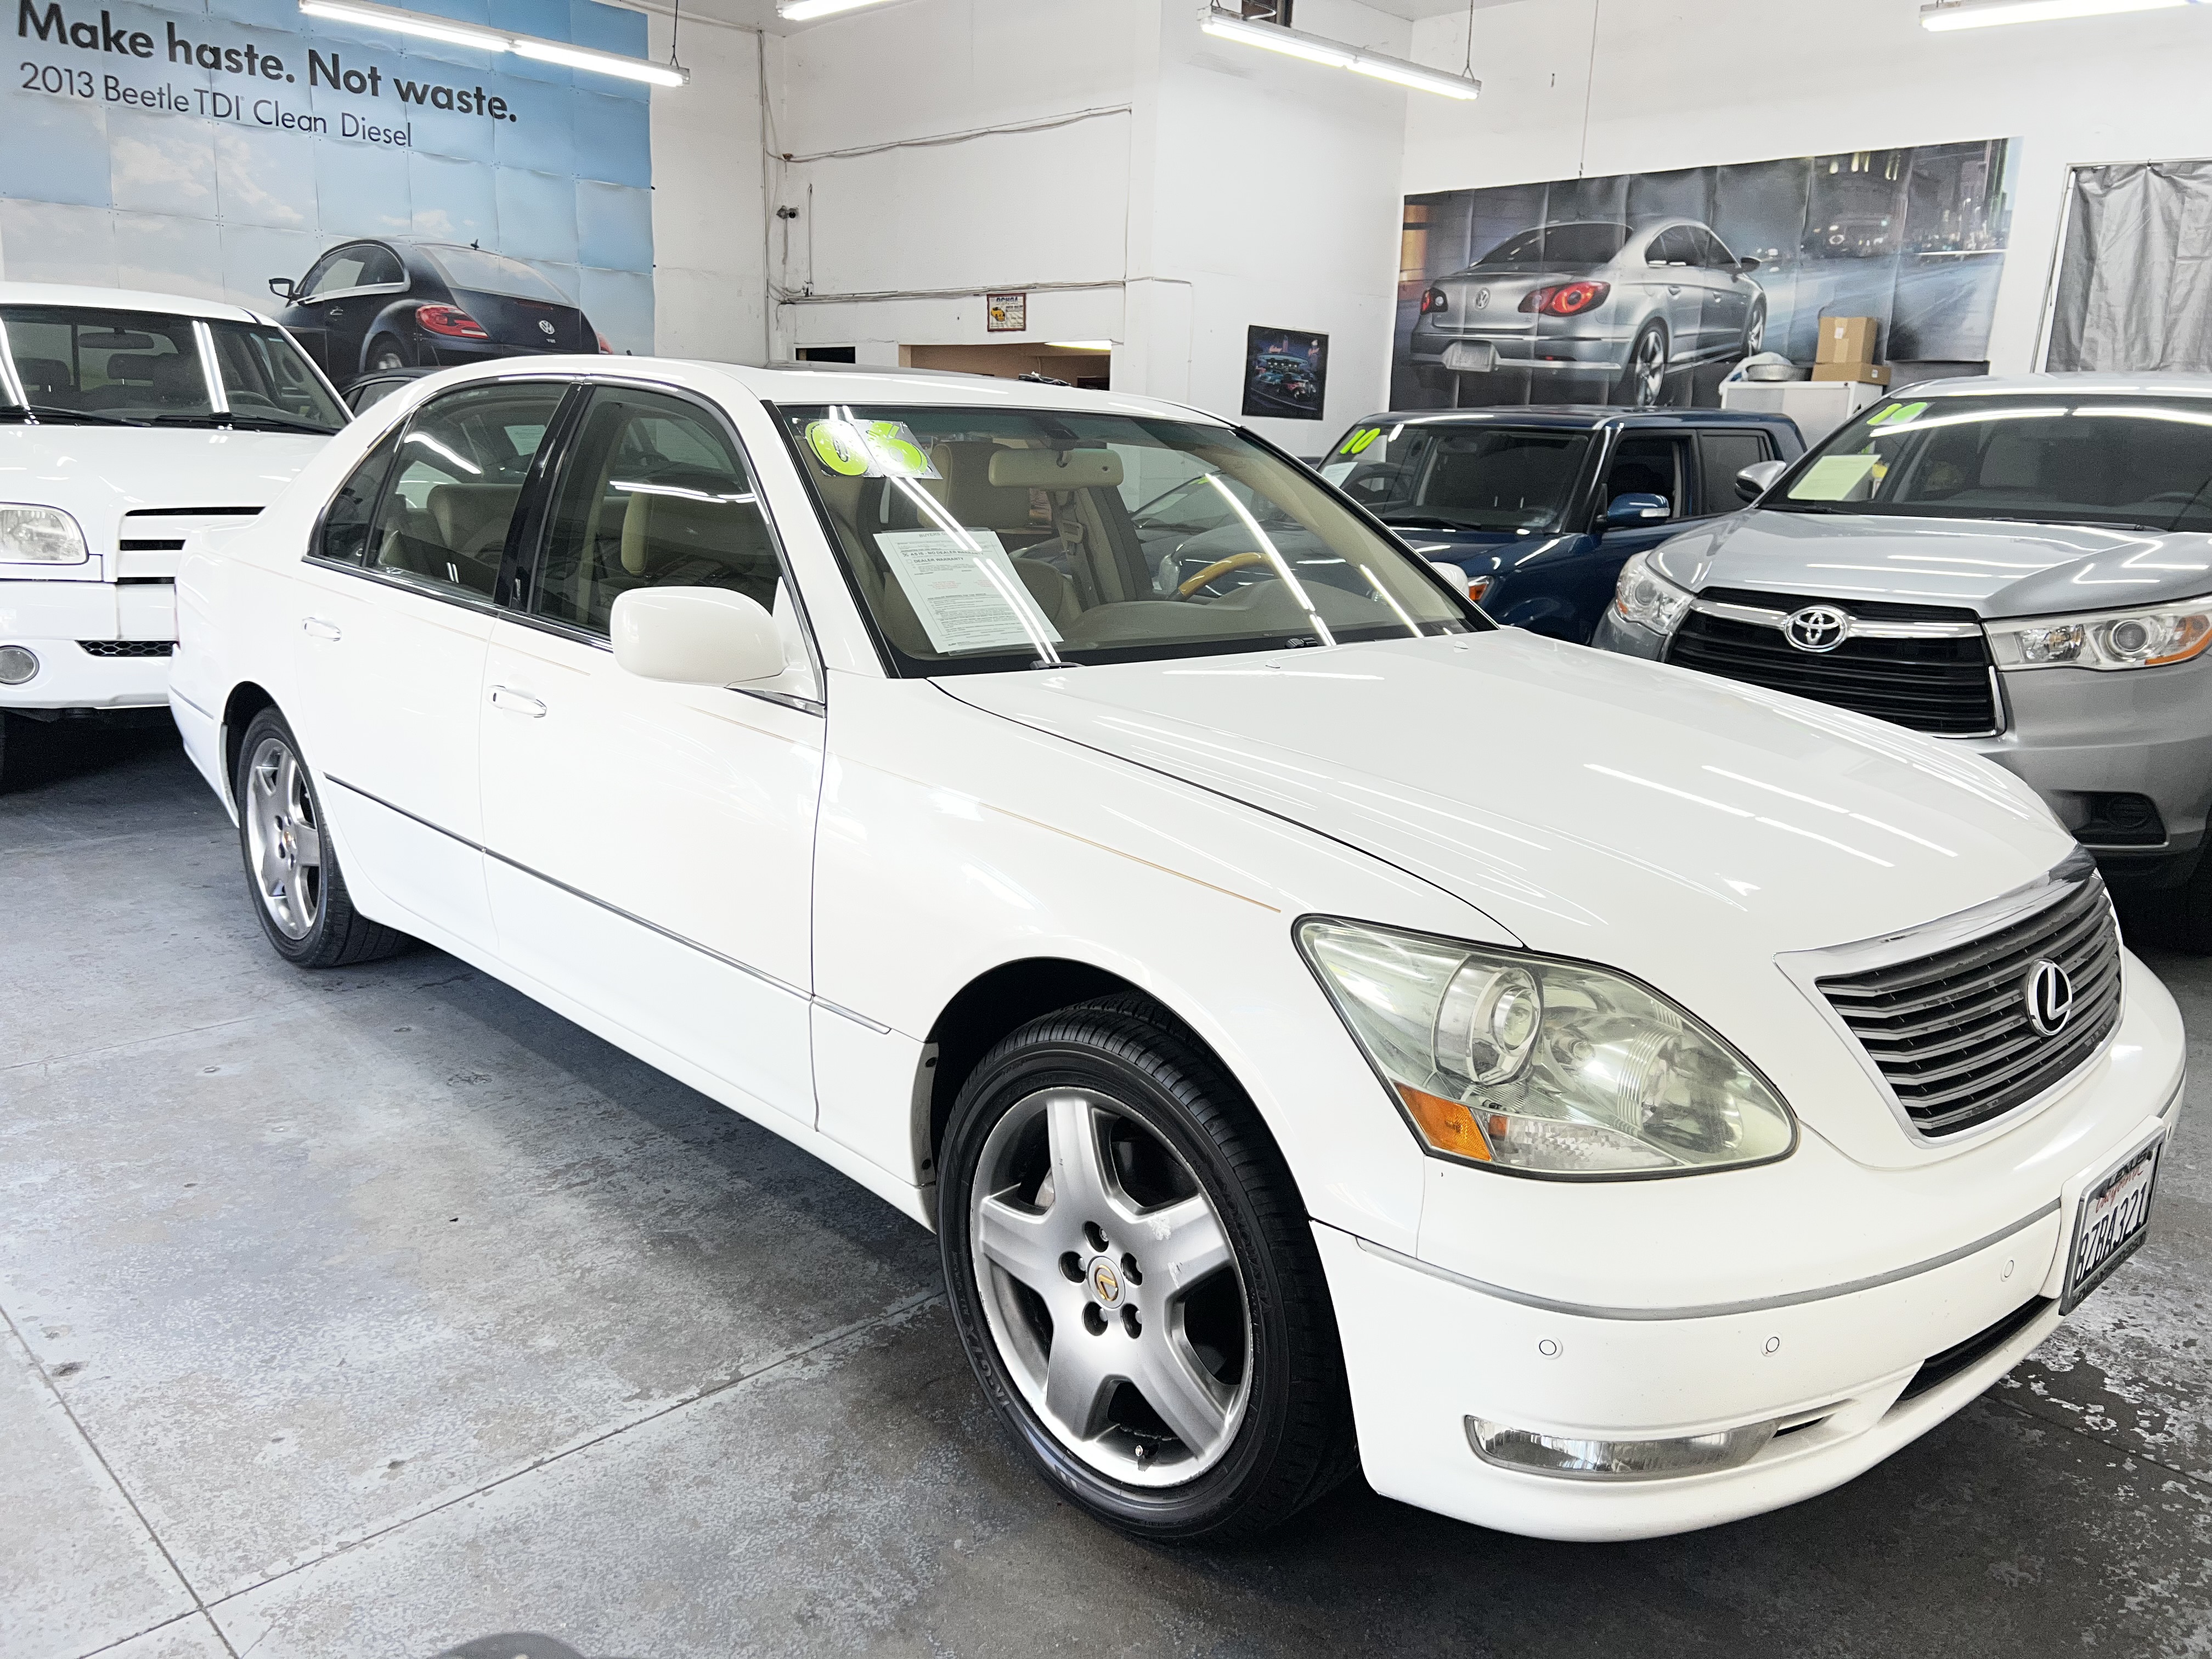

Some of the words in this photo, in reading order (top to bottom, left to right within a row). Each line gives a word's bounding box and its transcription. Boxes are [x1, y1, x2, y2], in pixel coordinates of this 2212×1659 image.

[18, 0, 155, 59] Make
[166, 21, 296, 83] haste.
[308, 49, 382, 97] Not
[393, 77, 517, 122] waste.
[20, 61, 95, 98] 2013
[104, 75, 190, 112] Beetle
[253, 99, 328, 133] Clean
[341, 112, 413, 147] Diesel
[1340, 427, 1381, 454] 10
[2074, 1181, 2147, 1285] 8ZBA321
